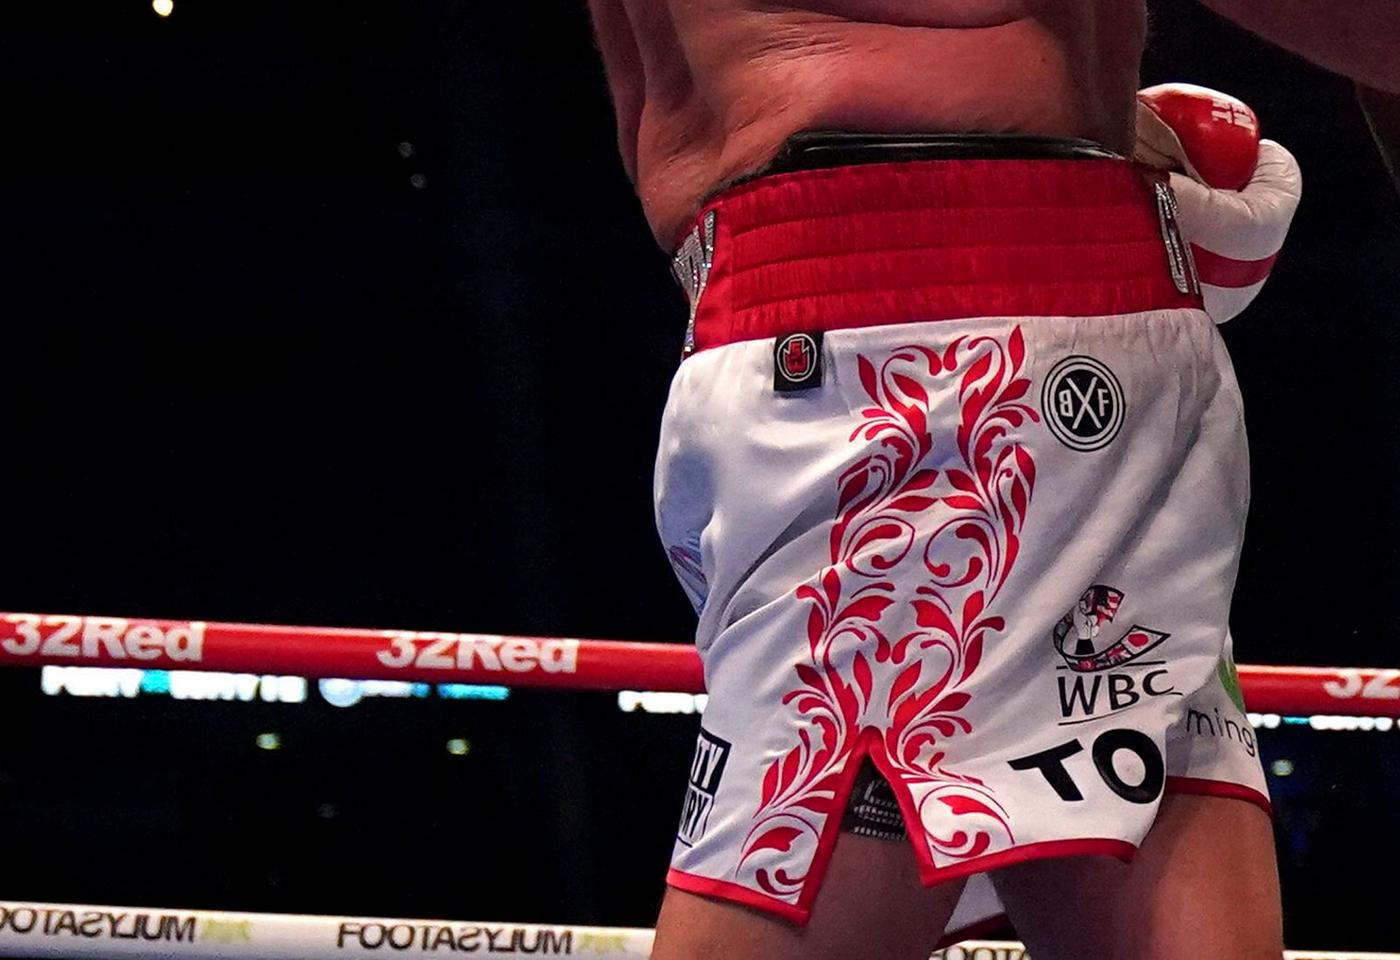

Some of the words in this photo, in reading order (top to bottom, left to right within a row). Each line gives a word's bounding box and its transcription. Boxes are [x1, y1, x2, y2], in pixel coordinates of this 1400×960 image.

[2, 613, 207, 662] 32Red
[375, 630, 580, 674] 32Red
[1057, 668, 1174, 718] WBC
[1186, 707, 1255, 757] ming
[1007, 728, 1165, 804] TO
